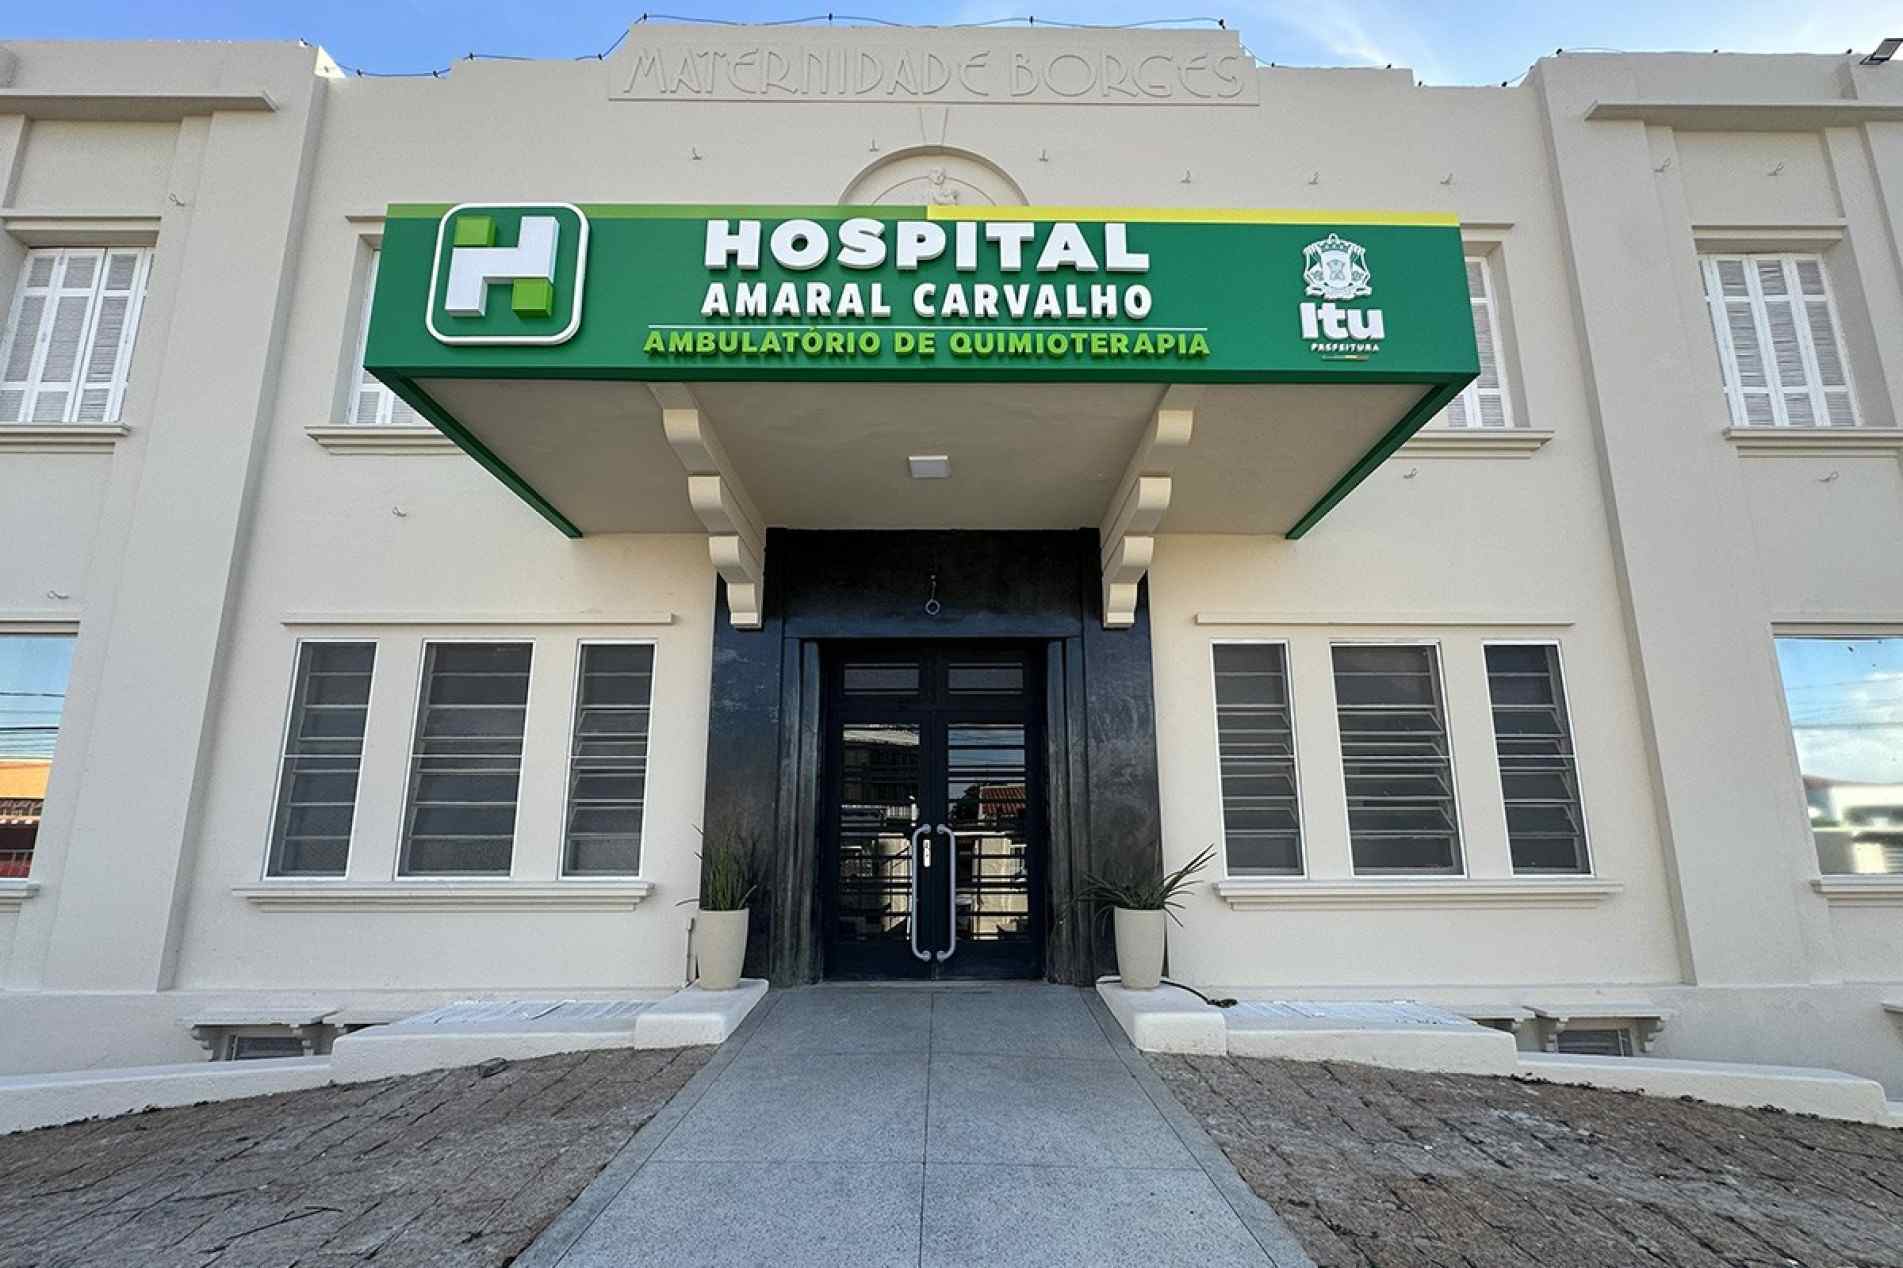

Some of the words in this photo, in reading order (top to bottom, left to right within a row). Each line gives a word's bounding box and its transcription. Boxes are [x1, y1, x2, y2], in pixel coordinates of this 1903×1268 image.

[622, 48, 990, 96] MATERNIDADE
[1008, 50, 1245, 98] BORGES
[704, 217, 1150, 272] HOSPITAL
[700, 281, 891, 318] AMARAL
[912, 282, 1153, 320] CARVALHO
[1300, 302, 1385, 340] Itu
[643, 326, 881, 356] AMBULATÓRIO
[894, 331, 936, 355] DE
[950, 331, 1211, 358] QUIMIOTERAPIA
